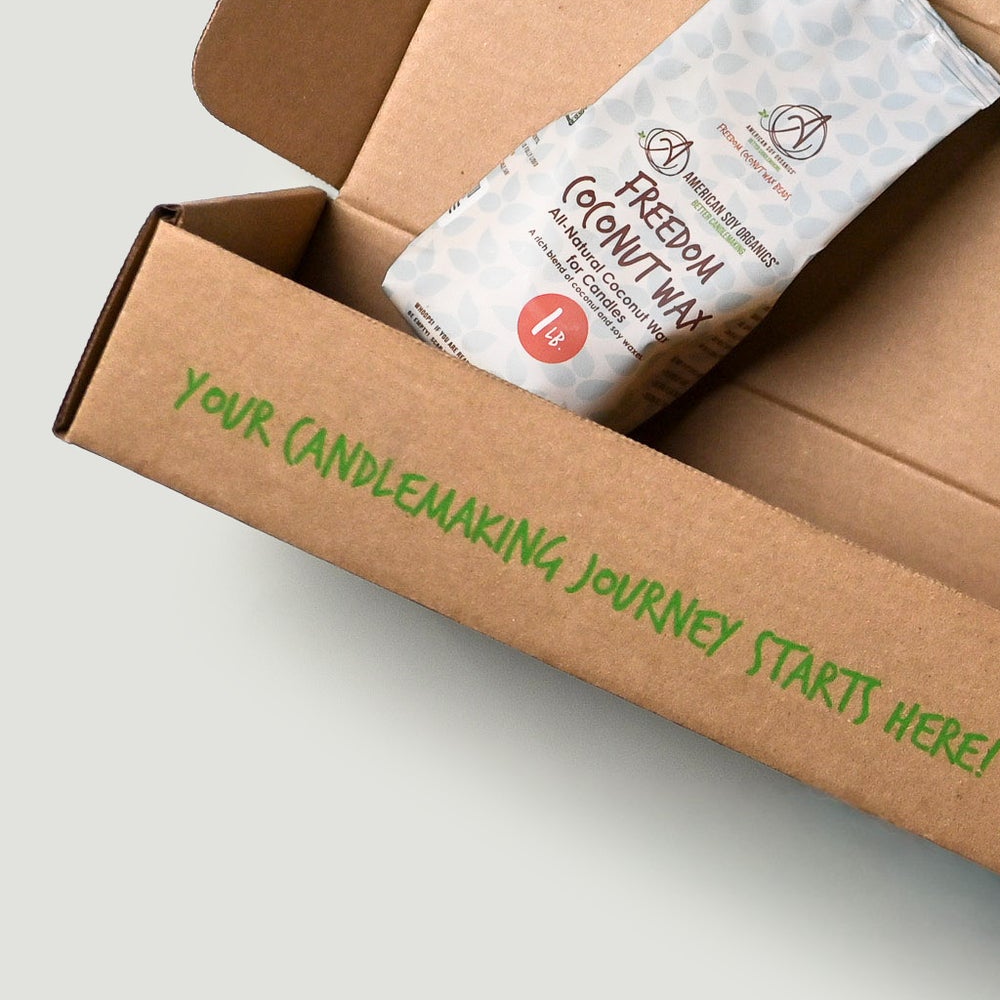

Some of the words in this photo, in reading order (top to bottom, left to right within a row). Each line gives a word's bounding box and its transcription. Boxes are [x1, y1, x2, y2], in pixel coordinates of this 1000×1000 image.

[716, 122, 743, 151] FREEDOM
[740, 149, 768, 176] COCONUT
[762, 171, 777, 185] WAX
[745, 124, 767, 148] AMERICAN
[614, 170, 725, 285] FREEDOM
[682, 171, 726, 218] AMERICAN
[721, 211, 741, 230] SOY
[690, 199, 710, 221] BETTER
[708, 217, 746, 256] CANDLEMAKING
[528, 228, 536, 236] A
[534, 234, 548, 252] rich
[546, 250, 567, 274] blend
[564, 272, 574, 283] of
[571, 282, 600, 312] coconut
[597, 310, 612, 327] and
[610, 325, 624, 340] soy
[548, 207, 606, 273] All-Natural
[602, 272, 650, 322] Coconut
[562, 175, 672, 283] COCONUT
[651, 277, 713, 332] WAX
[531, 307, 563, 336] 1
[566, 254, 584, 275] for
[582, 274, 626, 324] Candles
[439, 330, 450, 343] YOU
[448, 341, 459, 353] ARE
[174, 367, 276, 447] YOUR
[283, 416, 568, 583] CANDLEMAKING
[564, 553, 744, 657] JOURNEY
[745, 630, 882, 725] STARTS
